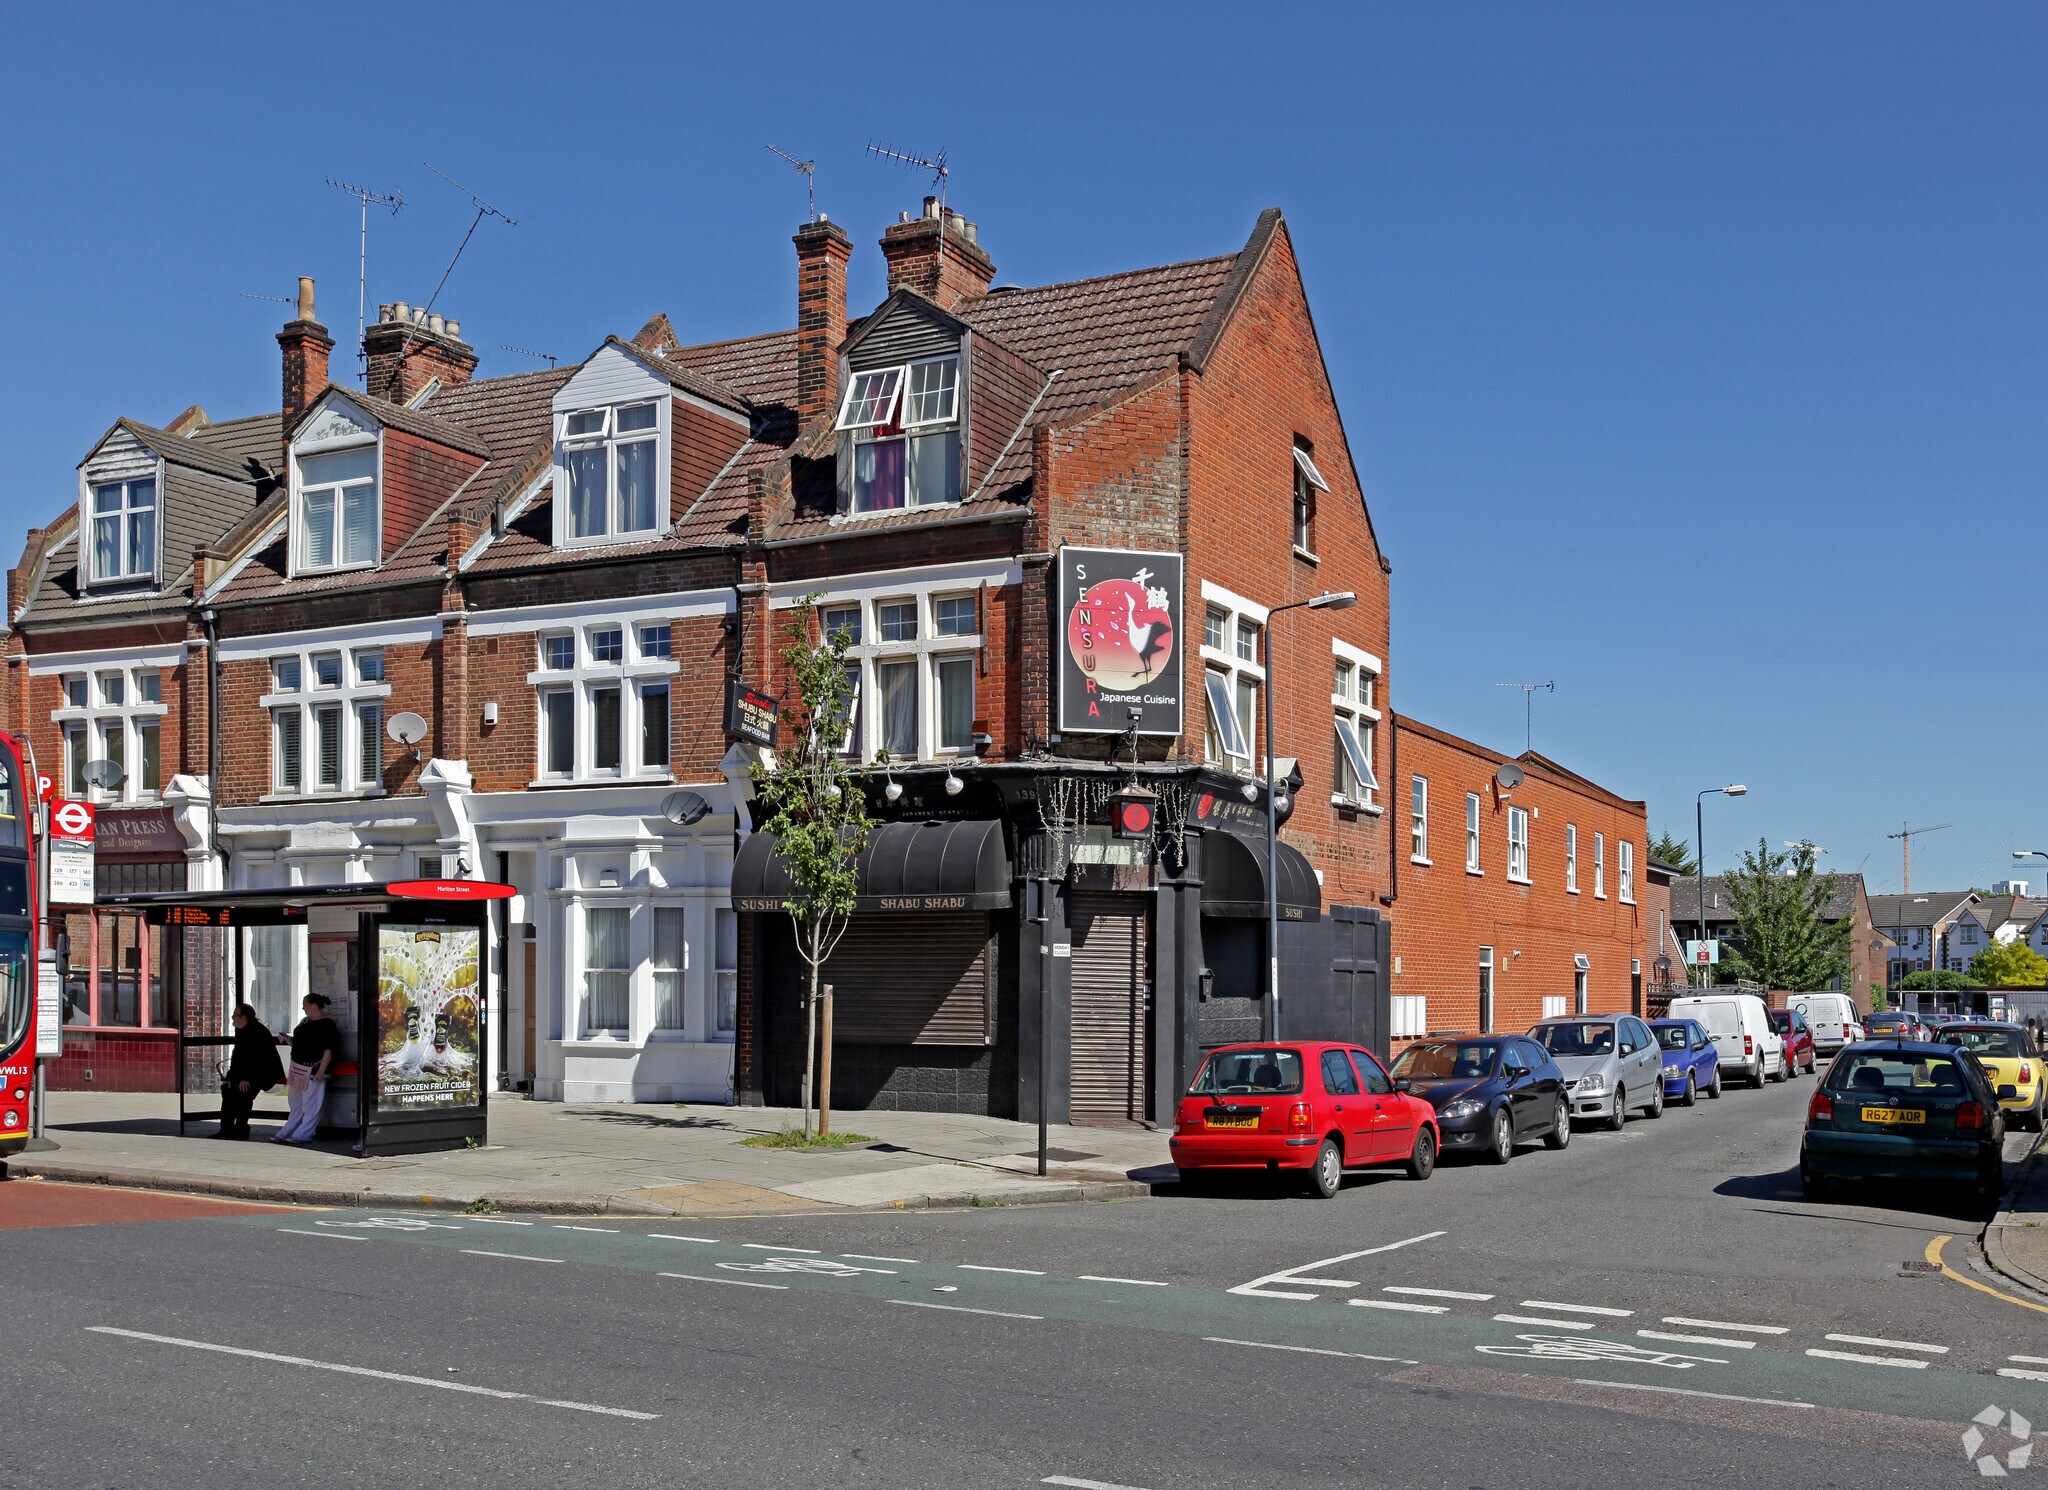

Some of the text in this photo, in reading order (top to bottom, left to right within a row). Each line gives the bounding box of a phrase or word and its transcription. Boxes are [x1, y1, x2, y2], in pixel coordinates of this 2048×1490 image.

[1131, 567, 1170, 612] 千鶴
[1075, 564, 1101, 717] SENSURA
[744, 692, 772, 710] Sushi
[1099, 692, 1176, 705] Japanese Cuisine
[737, 699, 777, 723] SHUBU SHABU
[741, 723, 770, 740] SEAFOOD BAR
[120, 819, 166, 835] PRESS
[118, 838, 152, 849] Designers
[741, 897, 965, 910] SUSHI SHABU SHABU
[1285, 907, 1303, 919] SUSHI
[384, 1080, 471, 1093] NEW FROZEN FRUIT CIDER
[402, 1093, 454, 1103] HAPPENS HERE
[1866, 1110, 1921, 1122] R627 AOR
